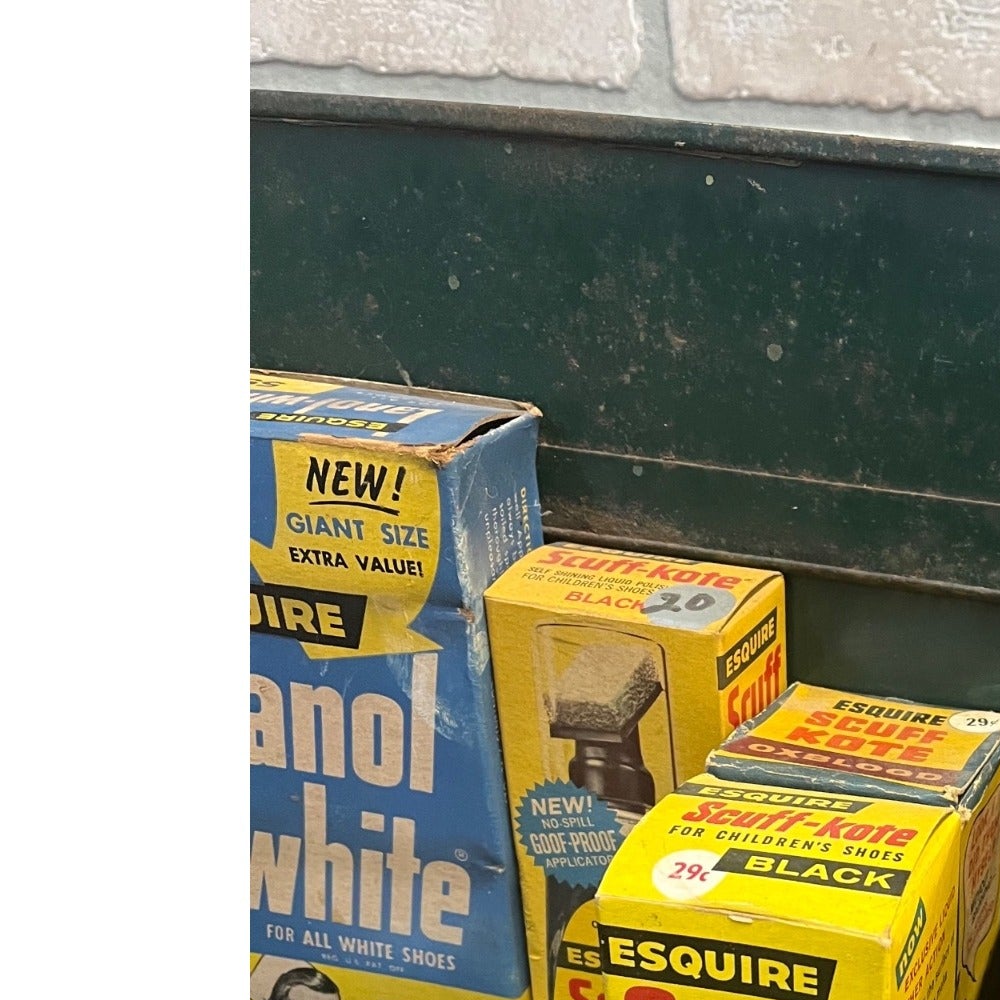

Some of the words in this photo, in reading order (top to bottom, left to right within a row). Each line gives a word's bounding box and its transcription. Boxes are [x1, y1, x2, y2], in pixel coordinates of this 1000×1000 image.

[256, 413, 388, 430] ESQUIRE
[306, 456, 406, 501] NEW!
[286, 513, 364, 540] GIANT
[382, 523, 429, 549] SIZE
[289, 547, 348, 569] EXTRA
[355, 555, 424, 577] VALUE!
[527, 566, 556, 575] SELF
[554, 570, 596, 580] SHINING
[598, 575, 633, 586] LIQUID
[636, 580, 669, 590] POLIS
[537, 550, 744, 590] Scuff-kote
[522, 572, 547, 583] FOR
[547, 576, 615, 592] CHILDREN'S
[640, 592, 716, 614] 20
[725, 618, 776, 678] ESQUIRE
[803, 711, 948, 744] SCUFF
[833, 699, 947, 726] ESQUIRE
[747, 743, 944, 782] OXBLOOD
[786, 727, 934, 763] KOTE
[531, 796, 592, 816] NEW!
[697, 787, 853, 810] ESQUIRE
[541, 816, 594, 830] NO-SPILL
[681, 801, 918, 847] Scuff-kote
[530, 830, 617, 854] GOOF-PROOF
[668, 825, 705, 838] FOR
[715, 830, 832, 852] CHILDREN'S
[842, 846, 904, 863] SHOES
[250, 782, 471, 945] white
[744, 855, 895, 890] BLACK
[266, 924, 294, 942] FOR
[303, 930, 332, 950] ALL
[338, 936, 393, 960] WHITE
[402, 947, 456, 971] SHOES
[900, 907, 922, 977] now
[608, 937, 818, 996] ESQUIRE
